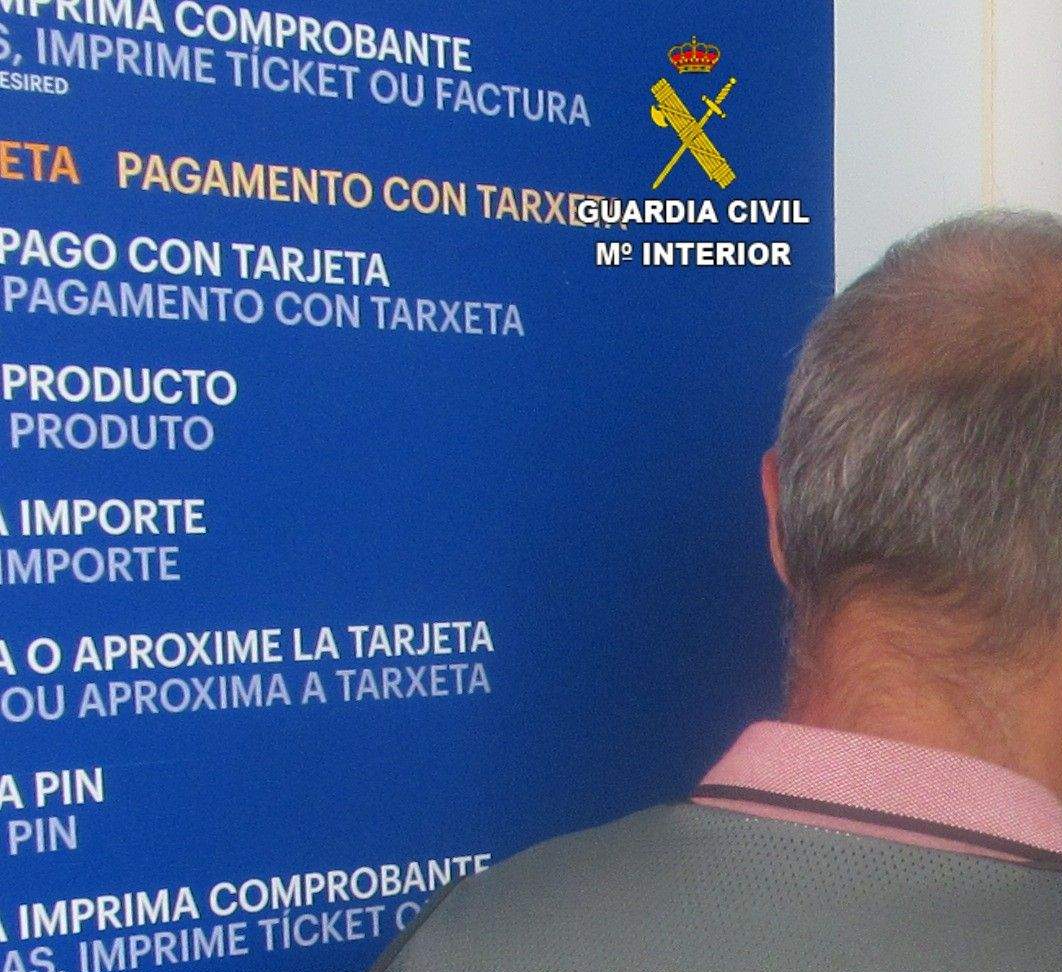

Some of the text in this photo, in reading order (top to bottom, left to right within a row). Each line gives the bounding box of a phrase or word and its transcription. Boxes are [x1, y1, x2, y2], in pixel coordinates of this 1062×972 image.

[175, 1, 472, 72] COMPROBANTE
[0, 71, 69, 95] ESIRED
[36, 27, 216, 85] IMPRIME
[226, 45, 360, 99] TÍCKET
[370, 70, 424, 107] OU
[436, 77, 591, 127] FACTURA
[0, 140, 80, 185] ETA
[117, 151, 628, 230] PAGAMENTO CON TARXE
[0, 228, 390, 287] PAGO CON TARJETA
[2, 275, 524, 336] PAGAMENTO CON TARXETA
[2, 364, 237, 405] PRODUCTO
[10, 412, 214, 450] PRODUTO
[20, 499, 206, 536] IMPORTE
[27, 637, 62, 674] O
[73, 628, 283, 672] APROXIME
[293, 627, 340, 661] LA
[348, 620, 495, 658] TARJETA
[1, 662, 491, 722] OU APROXIMA A TARXETA
[35, 767, 104, 807] PIN
[8, 815, 77, 855] PIN
[19, 886, 200, 940] IMPRIMA
[210, 853, 491, 916] COMPROBANTE
[258, 905, 385, 950] TÍCKET
